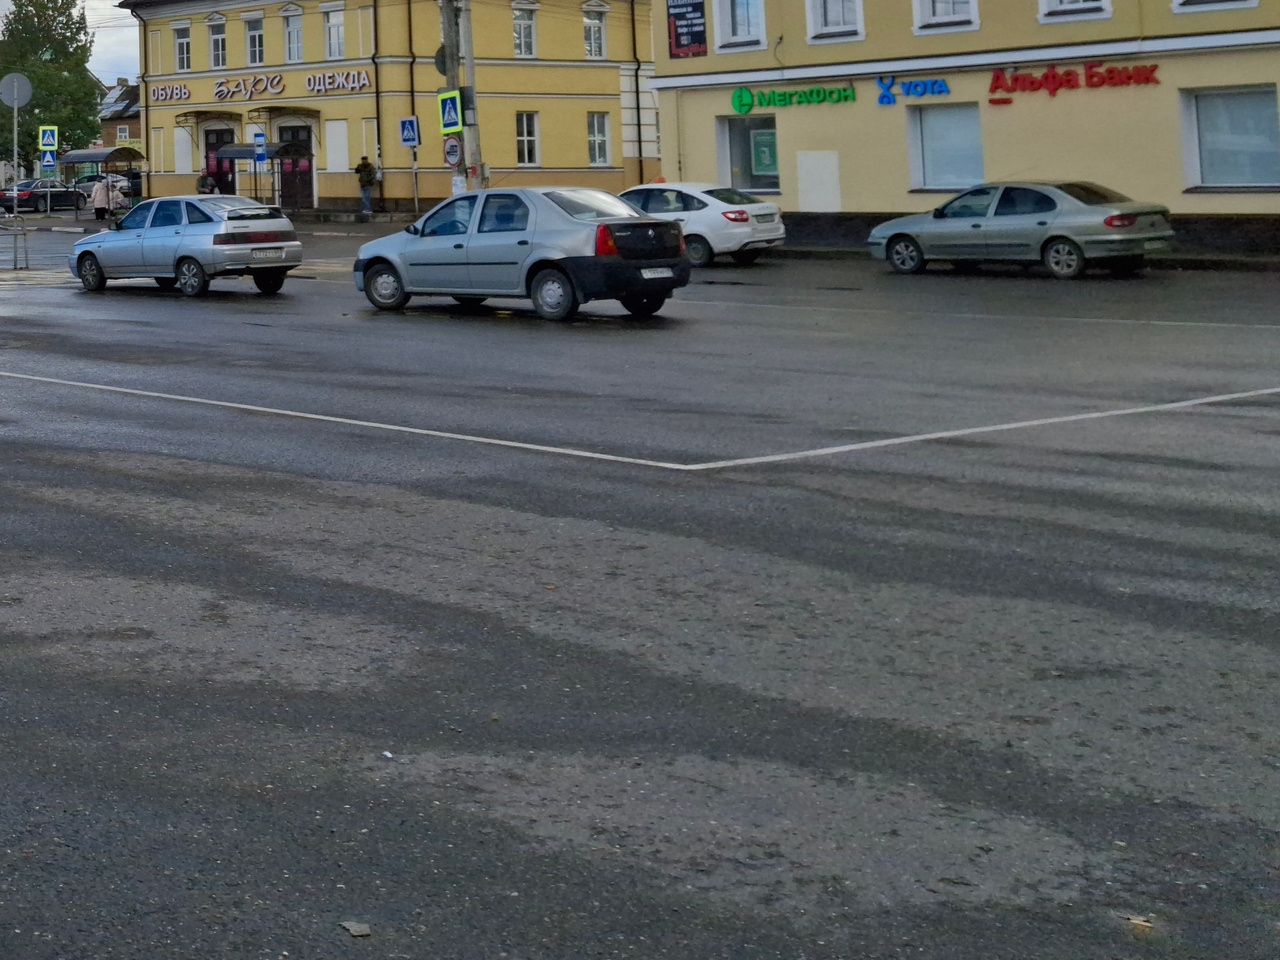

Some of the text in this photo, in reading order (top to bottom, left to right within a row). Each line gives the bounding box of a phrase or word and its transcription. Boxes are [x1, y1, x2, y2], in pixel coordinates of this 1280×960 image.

[151, 85, 190, 101] ОБУВЬ
[305, 71, 370, 92] ОДЕЖДА
[899, 79, 950, 97] YOTA
[988, 61, 1161, 97] Альфа Банк
[757, 86, 855, 107] МЕГАФОН
